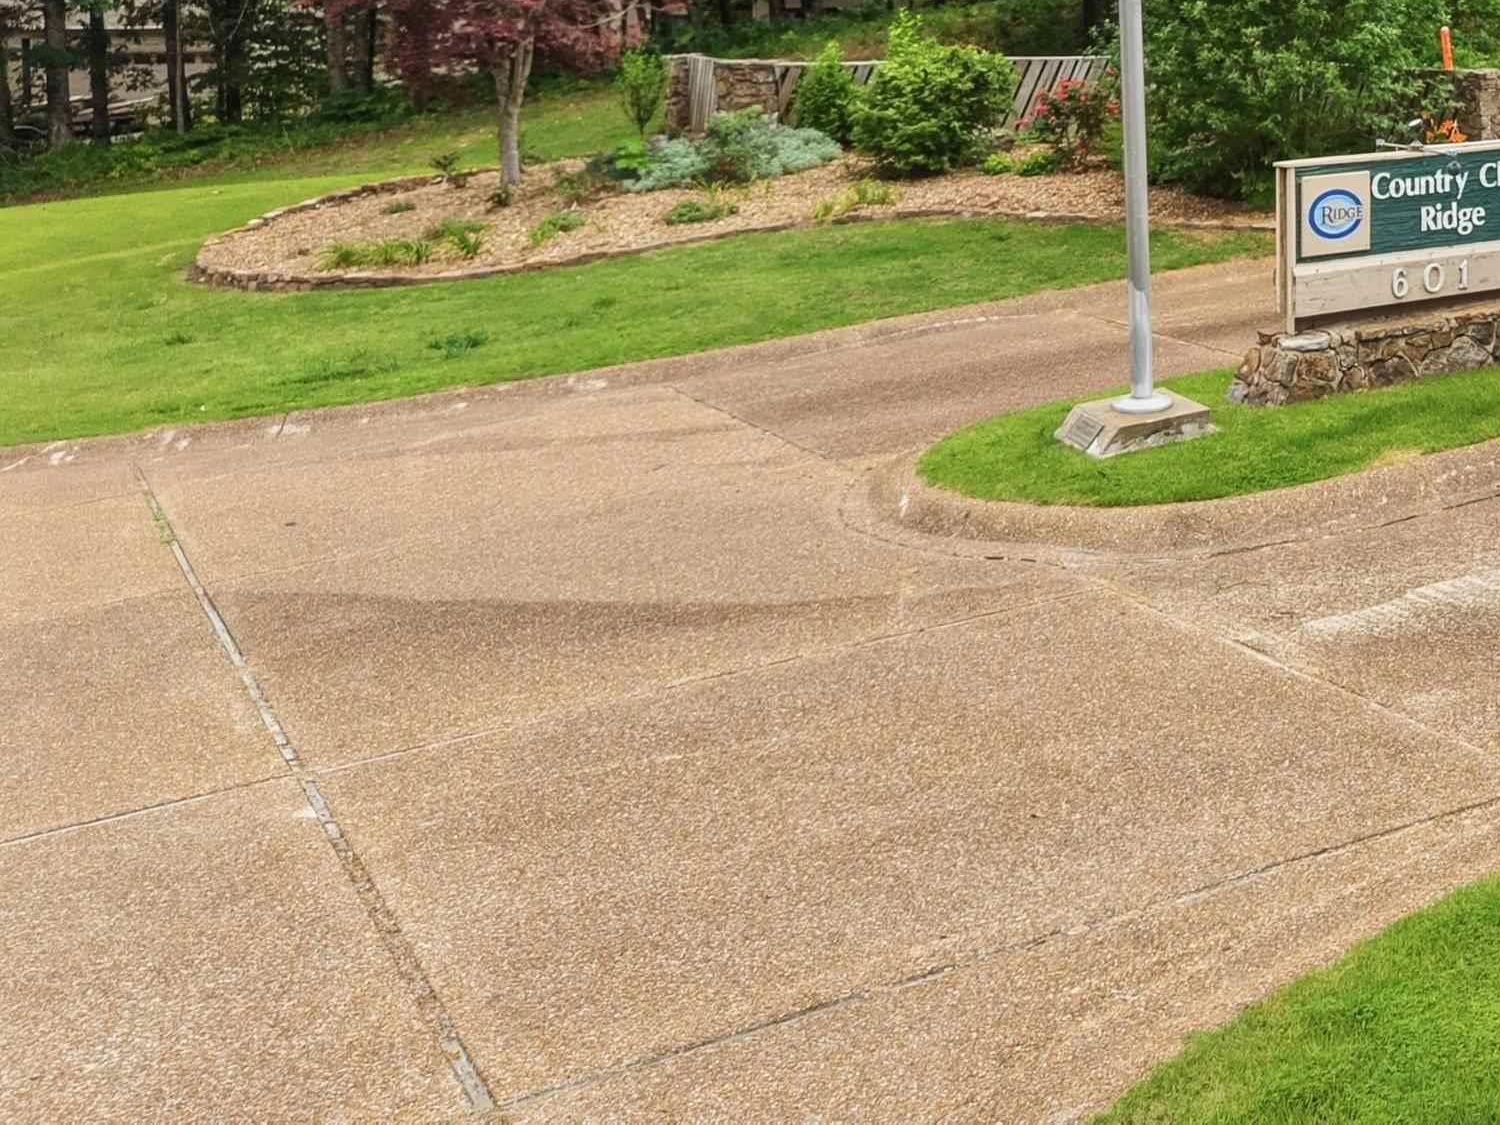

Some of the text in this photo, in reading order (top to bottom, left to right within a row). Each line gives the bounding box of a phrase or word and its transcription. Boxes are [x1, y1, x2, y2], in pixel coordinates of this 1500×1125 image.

[1371, 169, 1469, 200] Country
[1322, 205, 1363, 224] RIDGE
[1420, 202, 1486, 235] Ridge
[1392, 259, 1468, 299] 601
